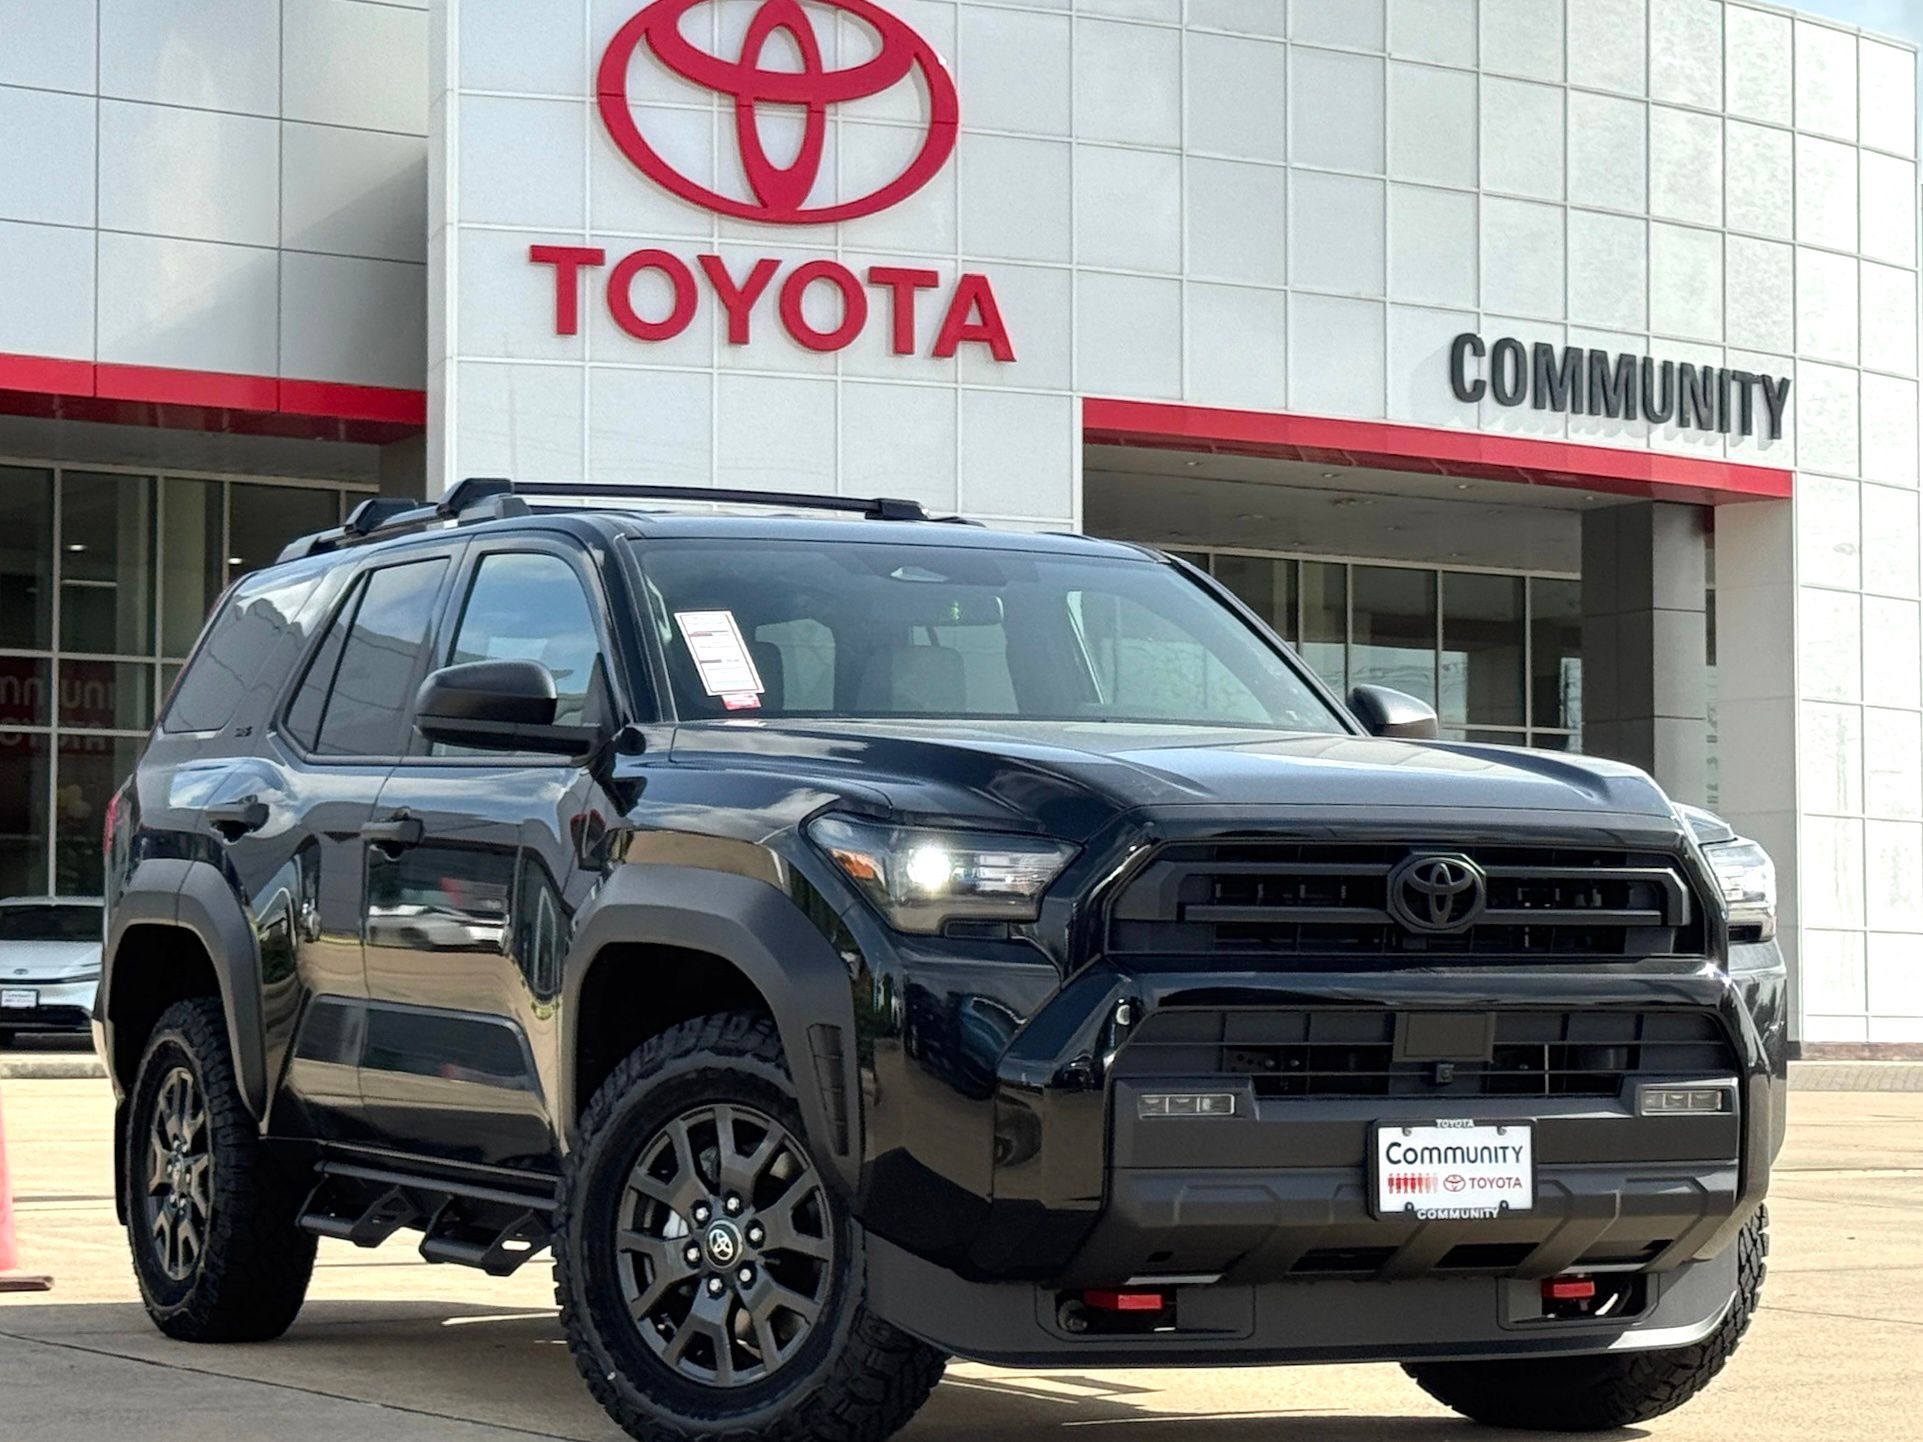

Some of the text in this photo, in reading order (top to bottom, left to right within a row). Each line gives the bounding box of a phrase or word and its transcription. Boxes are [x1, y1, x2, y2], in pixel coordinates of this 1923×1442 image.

[529, 244, 1018, 362] TOYOTA
[1450, 333, 1792, 439] COMMUNITY
[1435, 1119, 1475, 1128] TOYOTA
[1469, 1177, 1522, 1189] TOYOTA
[1417, 1208, 1499, 1220] COMMUNITY
